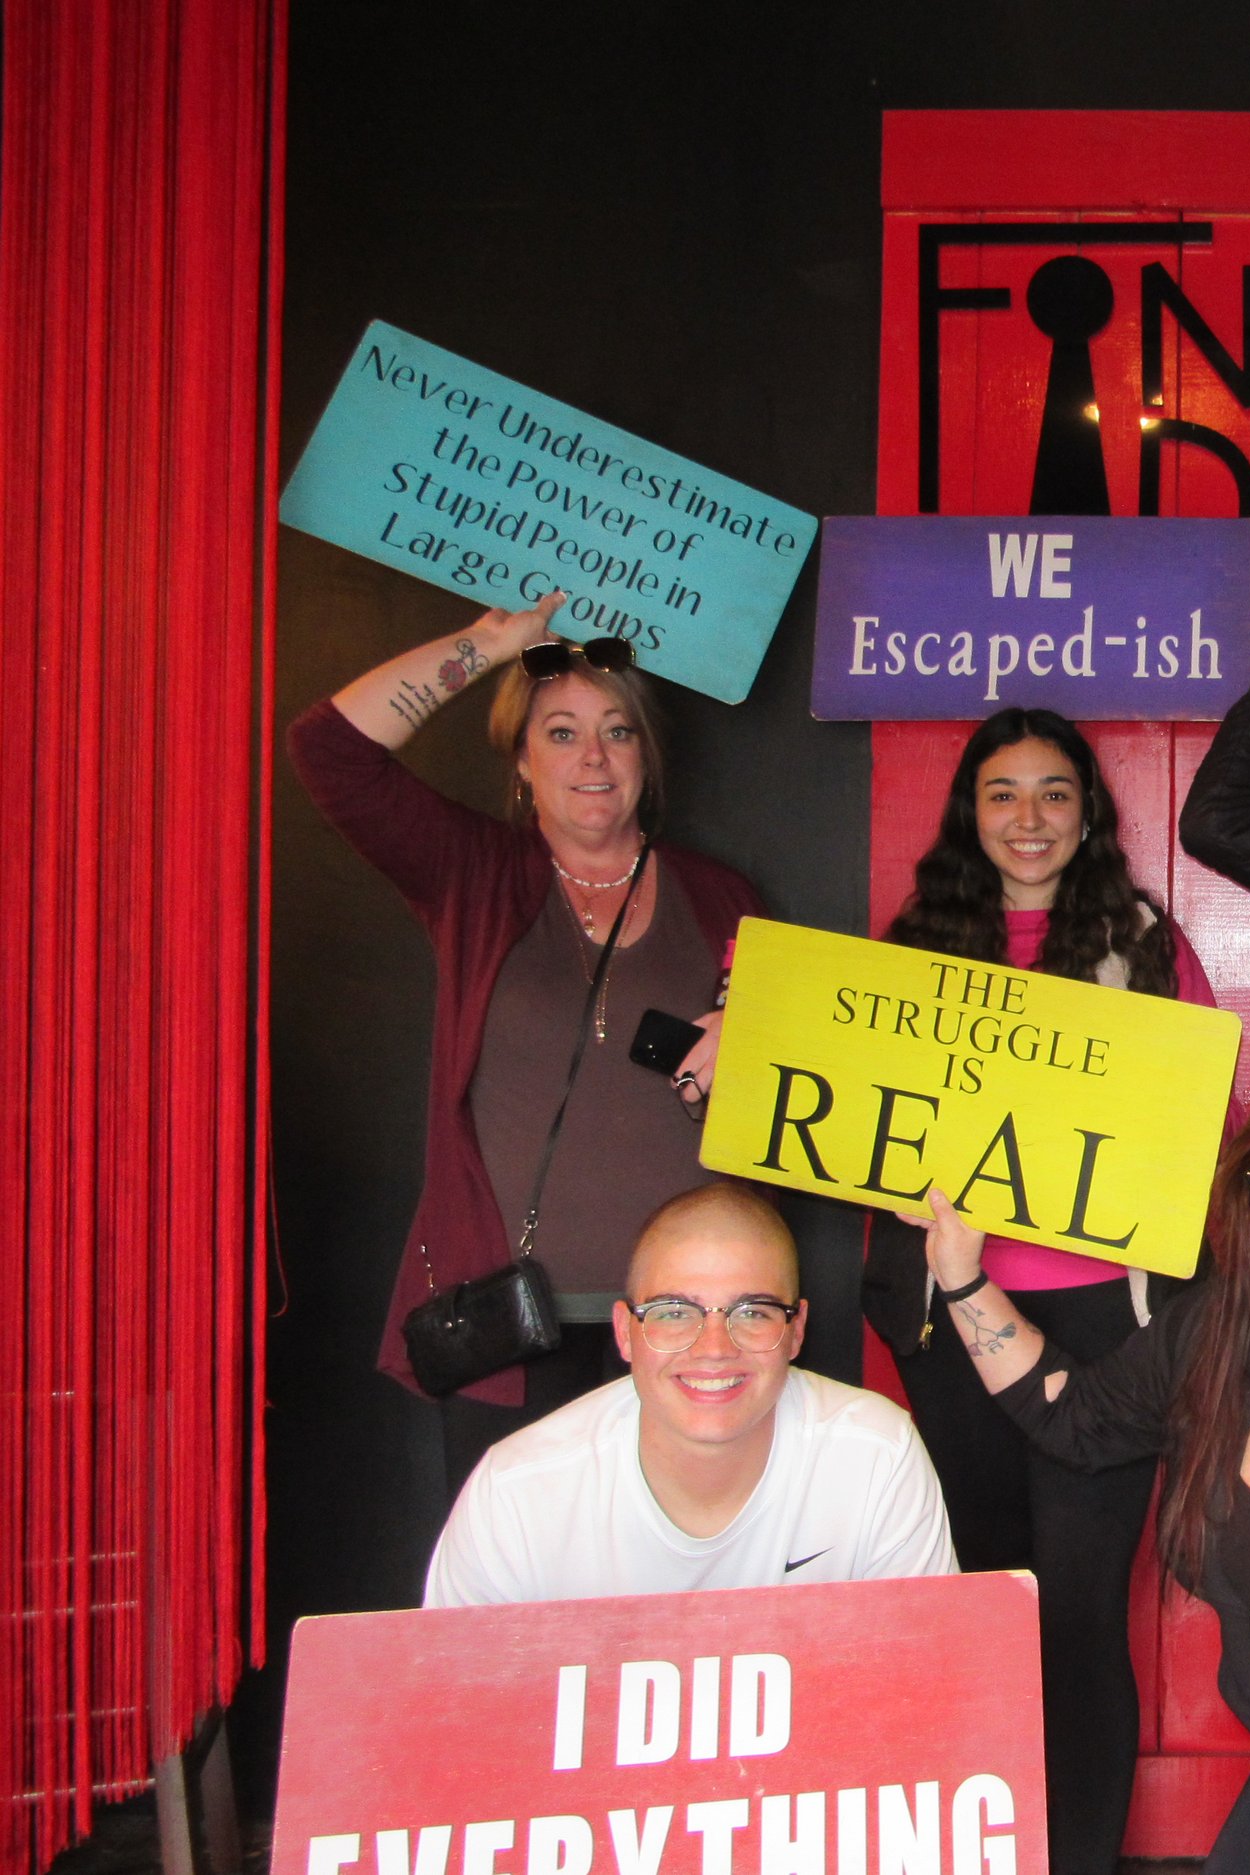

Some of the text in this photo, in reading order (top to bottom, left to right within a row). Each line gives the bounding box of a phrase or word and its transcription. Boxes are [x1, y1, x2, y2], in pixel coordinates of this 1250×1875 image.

[362, 346, 797, 556] Never Underestimate
[431, 425, 706, 562] the Power of
[380, 511, 511, 586] Large
[384, 462, 702, 616] Stupid People in
[988, 534, 1074, 598] WE
[849, 606, 1223, 701] Escaped-ish
[832, 987, 1110, 1078] STRUGGLE
[928, 962, 1030, 1014] THE
[942, 1053, 985, 1095] IS
[752, 1062, 1139, 1250] REAL
[552, 1652, 793, 1771] I DID
